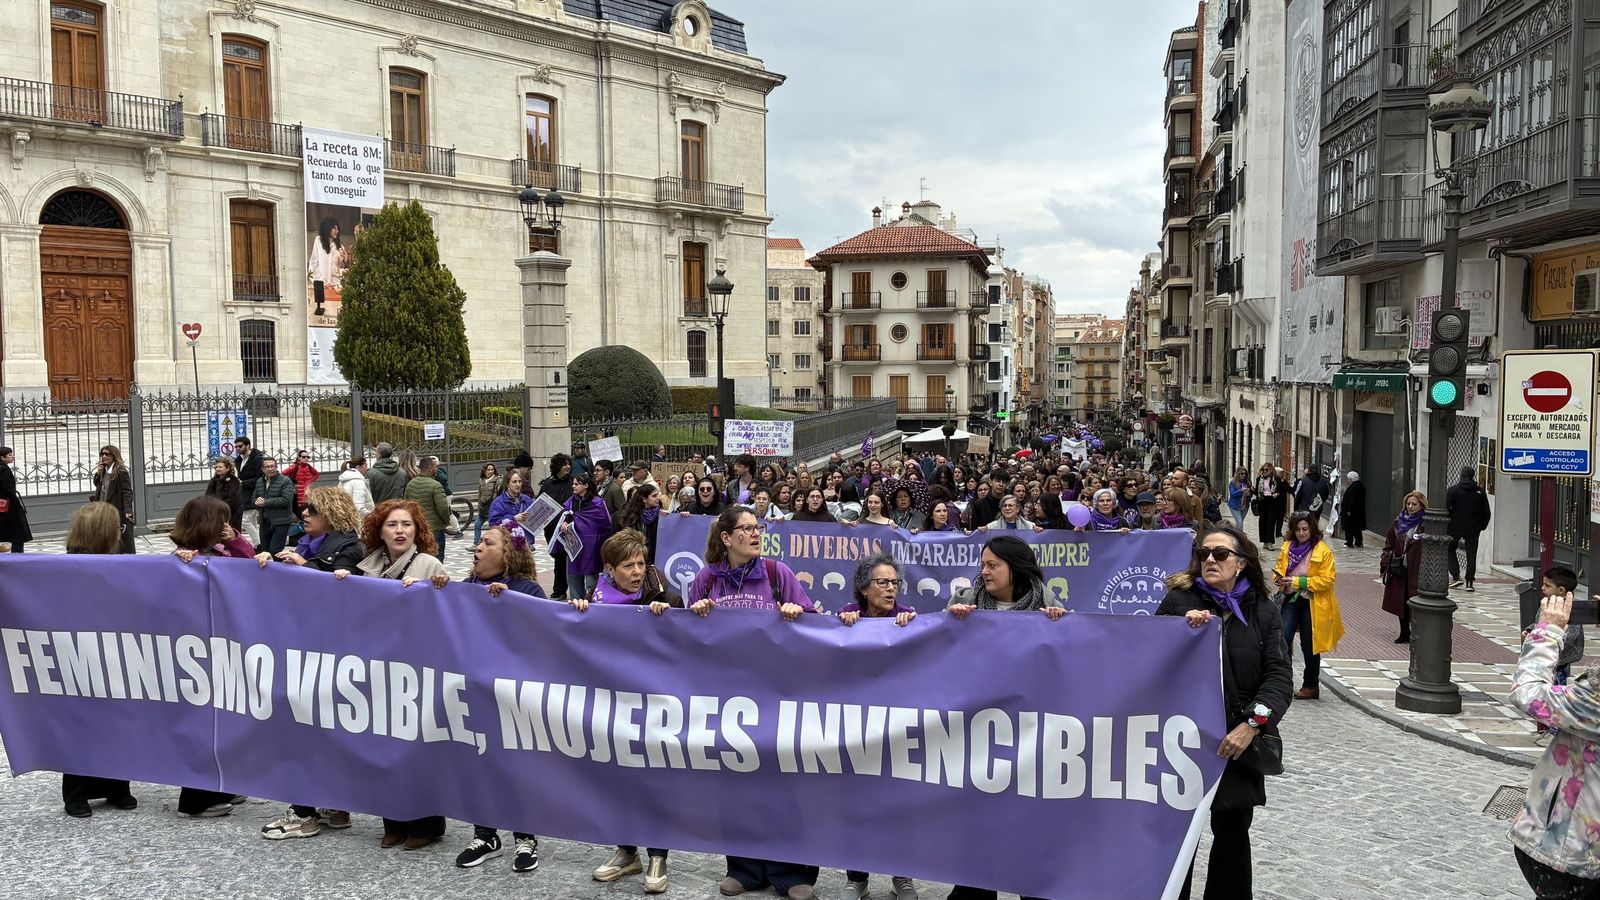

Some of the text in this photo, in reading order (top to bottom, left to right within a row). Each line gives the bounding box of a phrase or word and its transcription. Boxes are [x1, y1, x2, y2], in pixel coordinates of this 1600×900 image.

[305, 138, 382, 160] La receta 8M:
[307, 154, 381, 176] Recuerda lo que
[311, 170, 378, 187] tanto nos costó
[323, 185, 367, 198] conseguir
[317, 317, 336, 325] de las
[1507, 414, 1589, 423] EXCEPTO AUTORIZADOS,
[1513, 423, 1541, 431] PARKING
[742, 431, 755, 441] NO
[1546, 432, 1581, 440] DESCARGA
[789, 533, 882, 561] DIVERSAS
[1098, 566, 1148, 610] Feministas
[1, 628, 1205, 811] FEMINISMO VISIBLE, MUJERES INVENCIBLES
